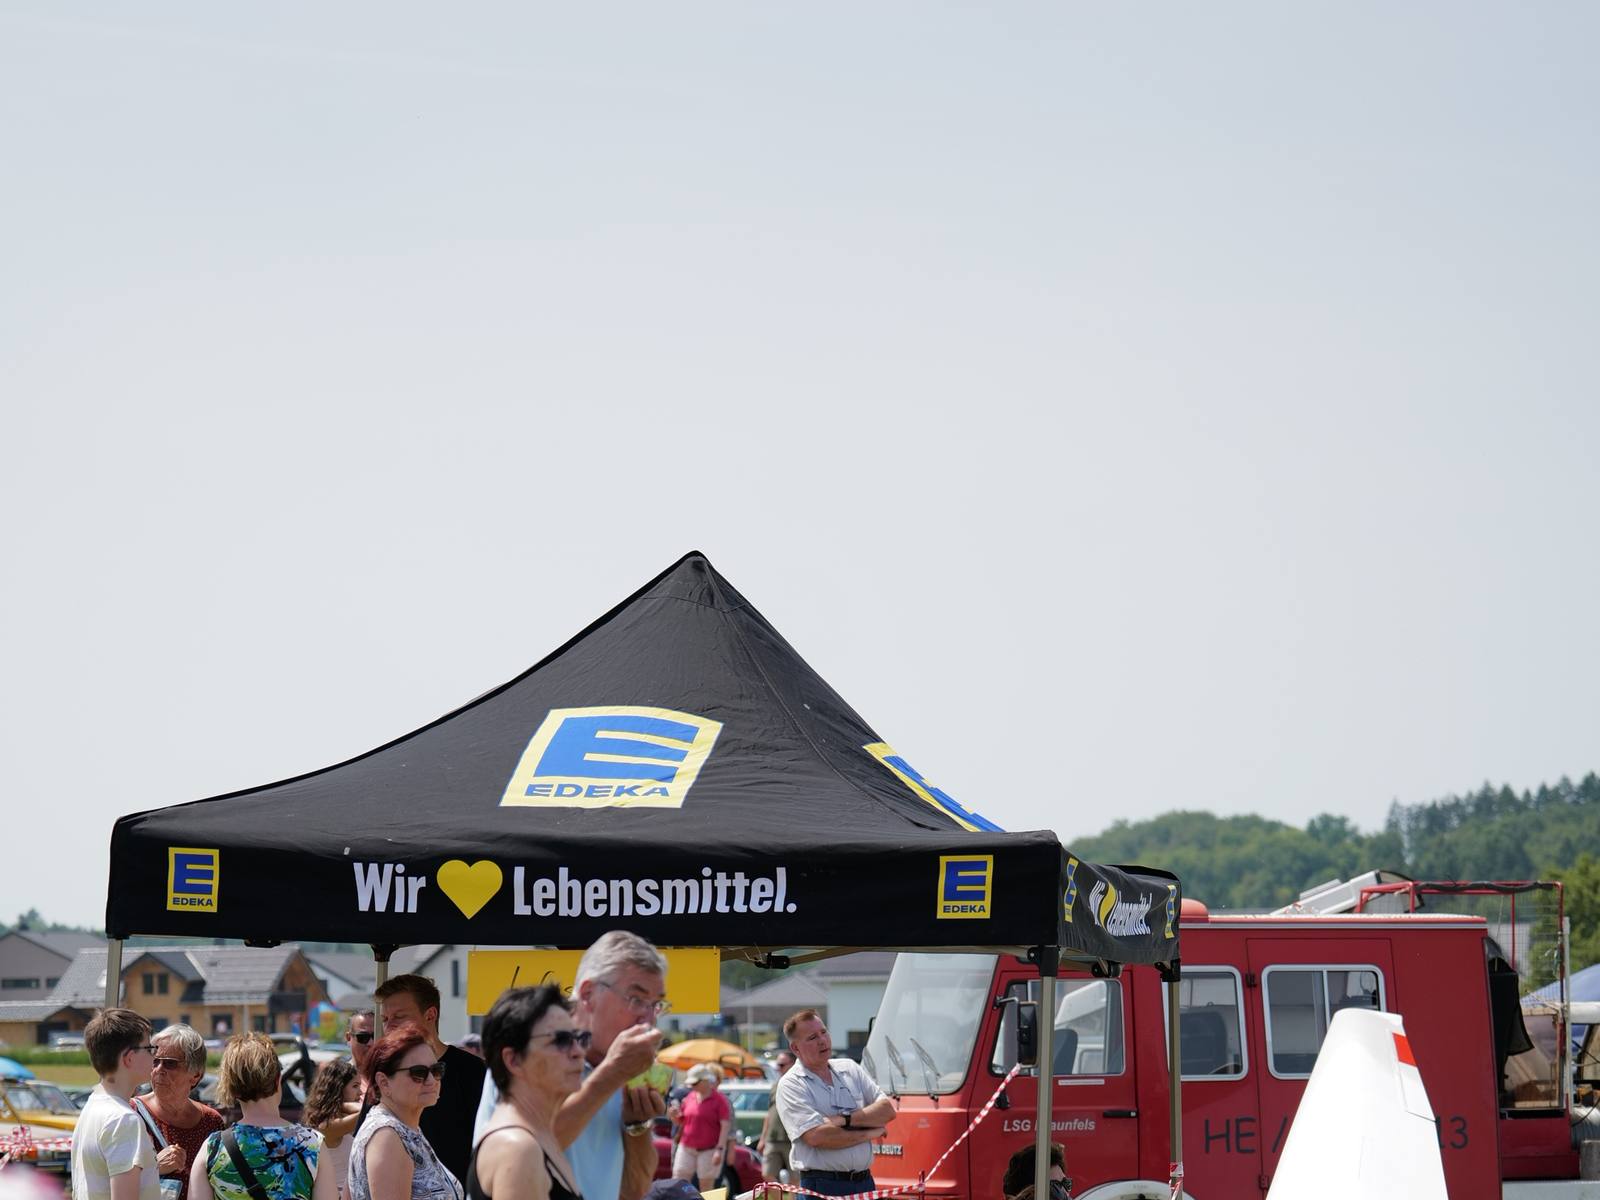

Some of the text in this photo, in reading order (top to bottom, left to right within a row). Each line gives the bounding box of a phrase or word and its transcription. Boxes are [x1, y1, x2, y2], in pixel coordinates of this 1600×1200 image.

[533, 715, 700, 783] E
[524, 783, 670, 798] EDEKA
[173, 853, 214, 895] E
[353, 862, 797, 917] Wir Lebensmittel.
[943, 860, 987, 901] E
[172, 897, 213, 907] EDEKA
[943, 904, 986, 914] EDEKA
[1003, 1119, 1031, 1132] LSG
[1204, 1116, 1257, 1153] HE
